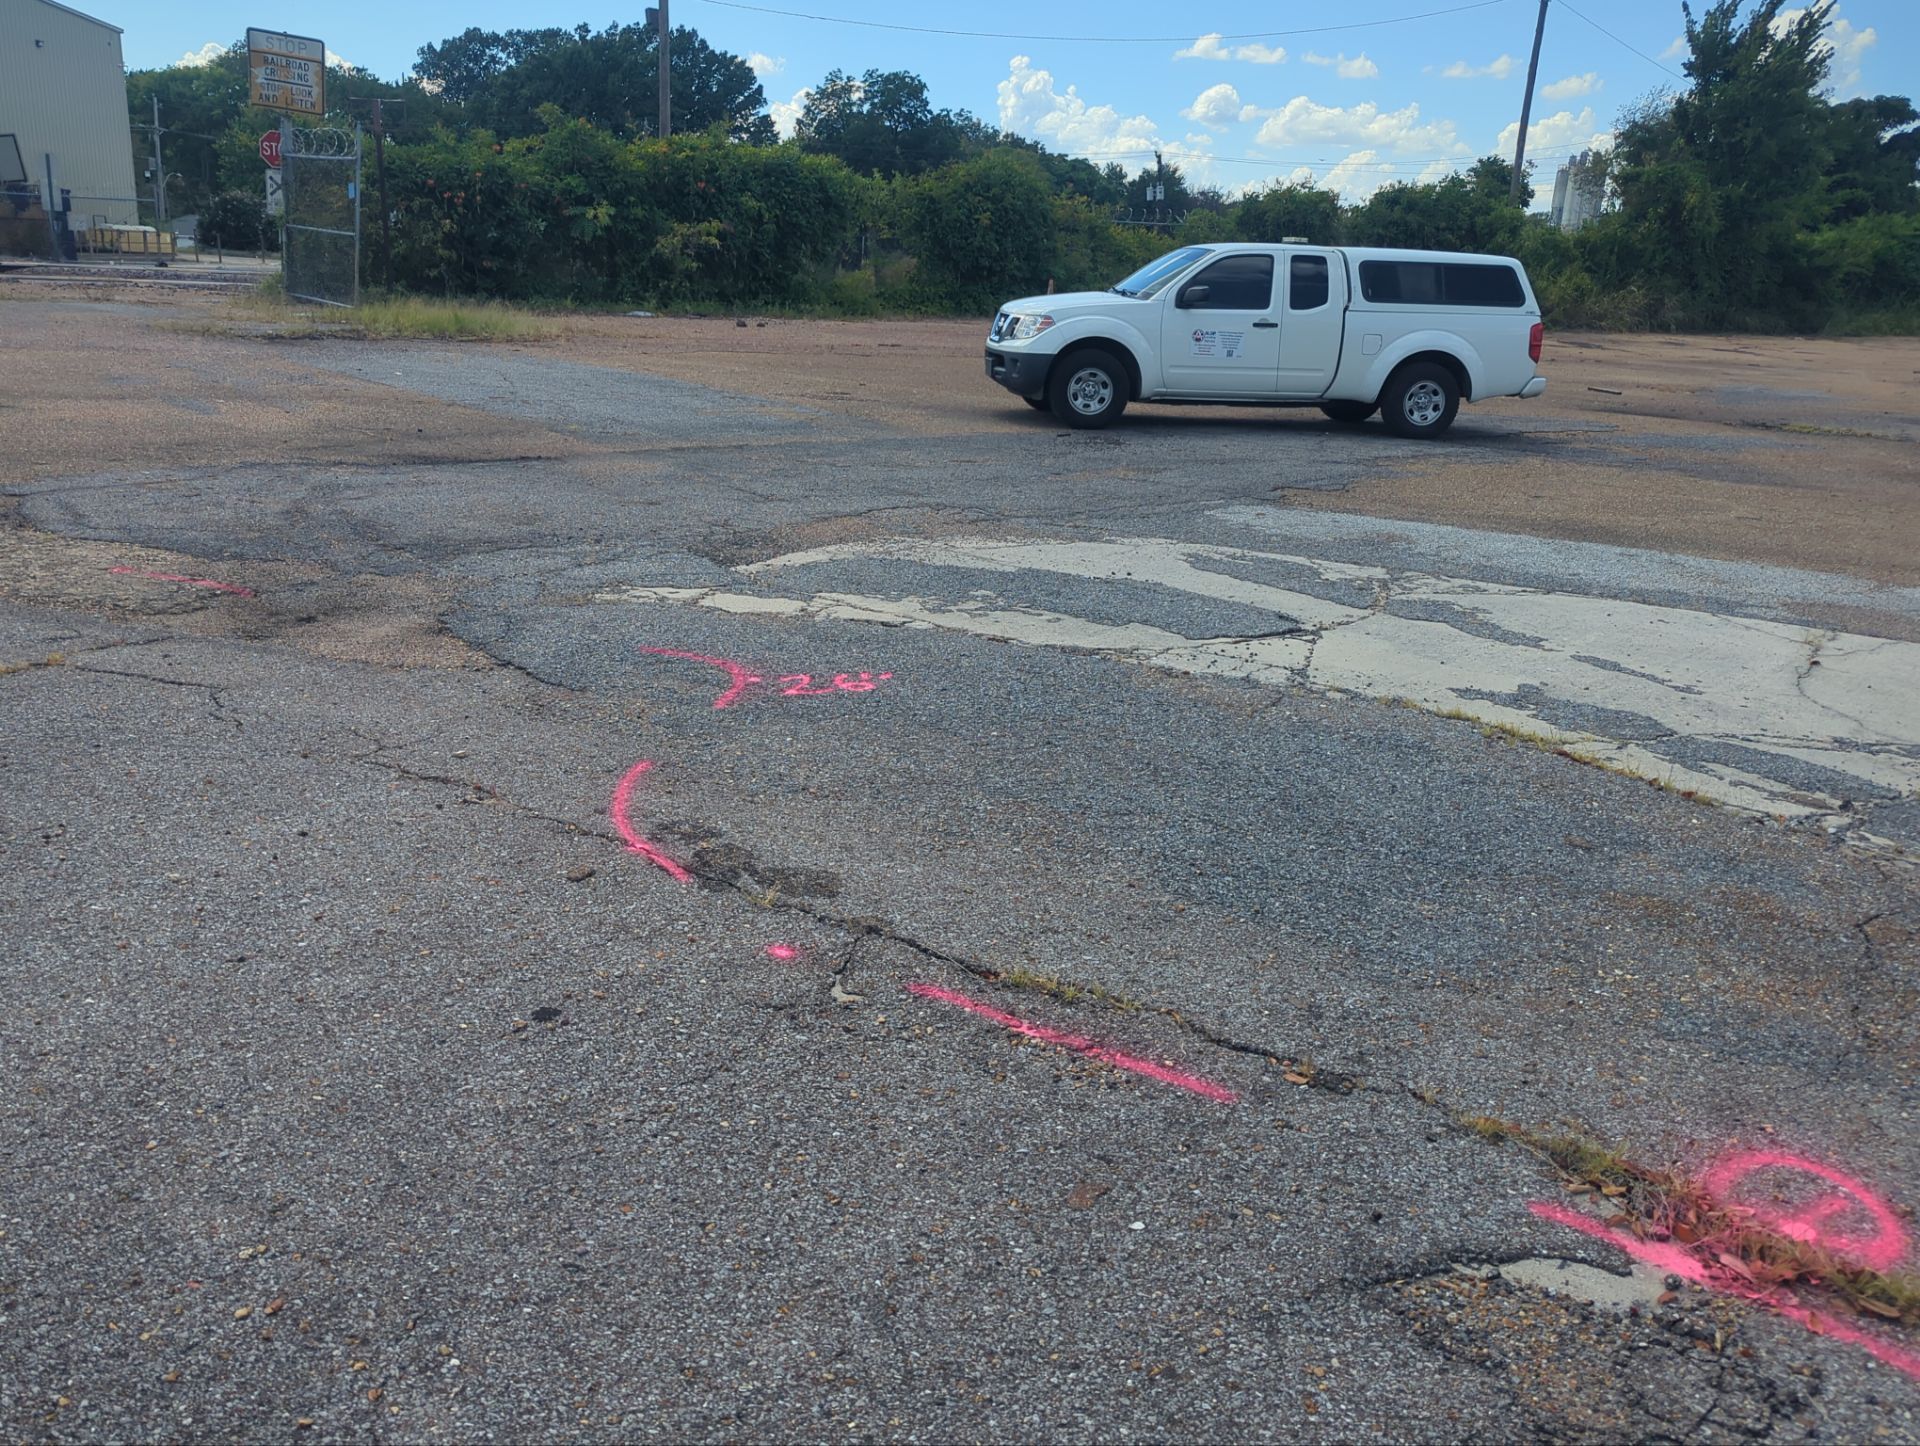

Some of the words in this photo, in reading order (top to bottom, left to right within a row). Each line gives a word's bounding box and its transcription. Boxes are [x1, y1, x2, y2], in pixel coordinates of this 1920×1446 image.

[265, 36, 307, 55] STOP
[263, 55, 310, 72] RAILROAD
[264, 67, 309, 83] CROING
[258, 93, 278, 104] AND
[290, 86, 314, 99] LOOK
